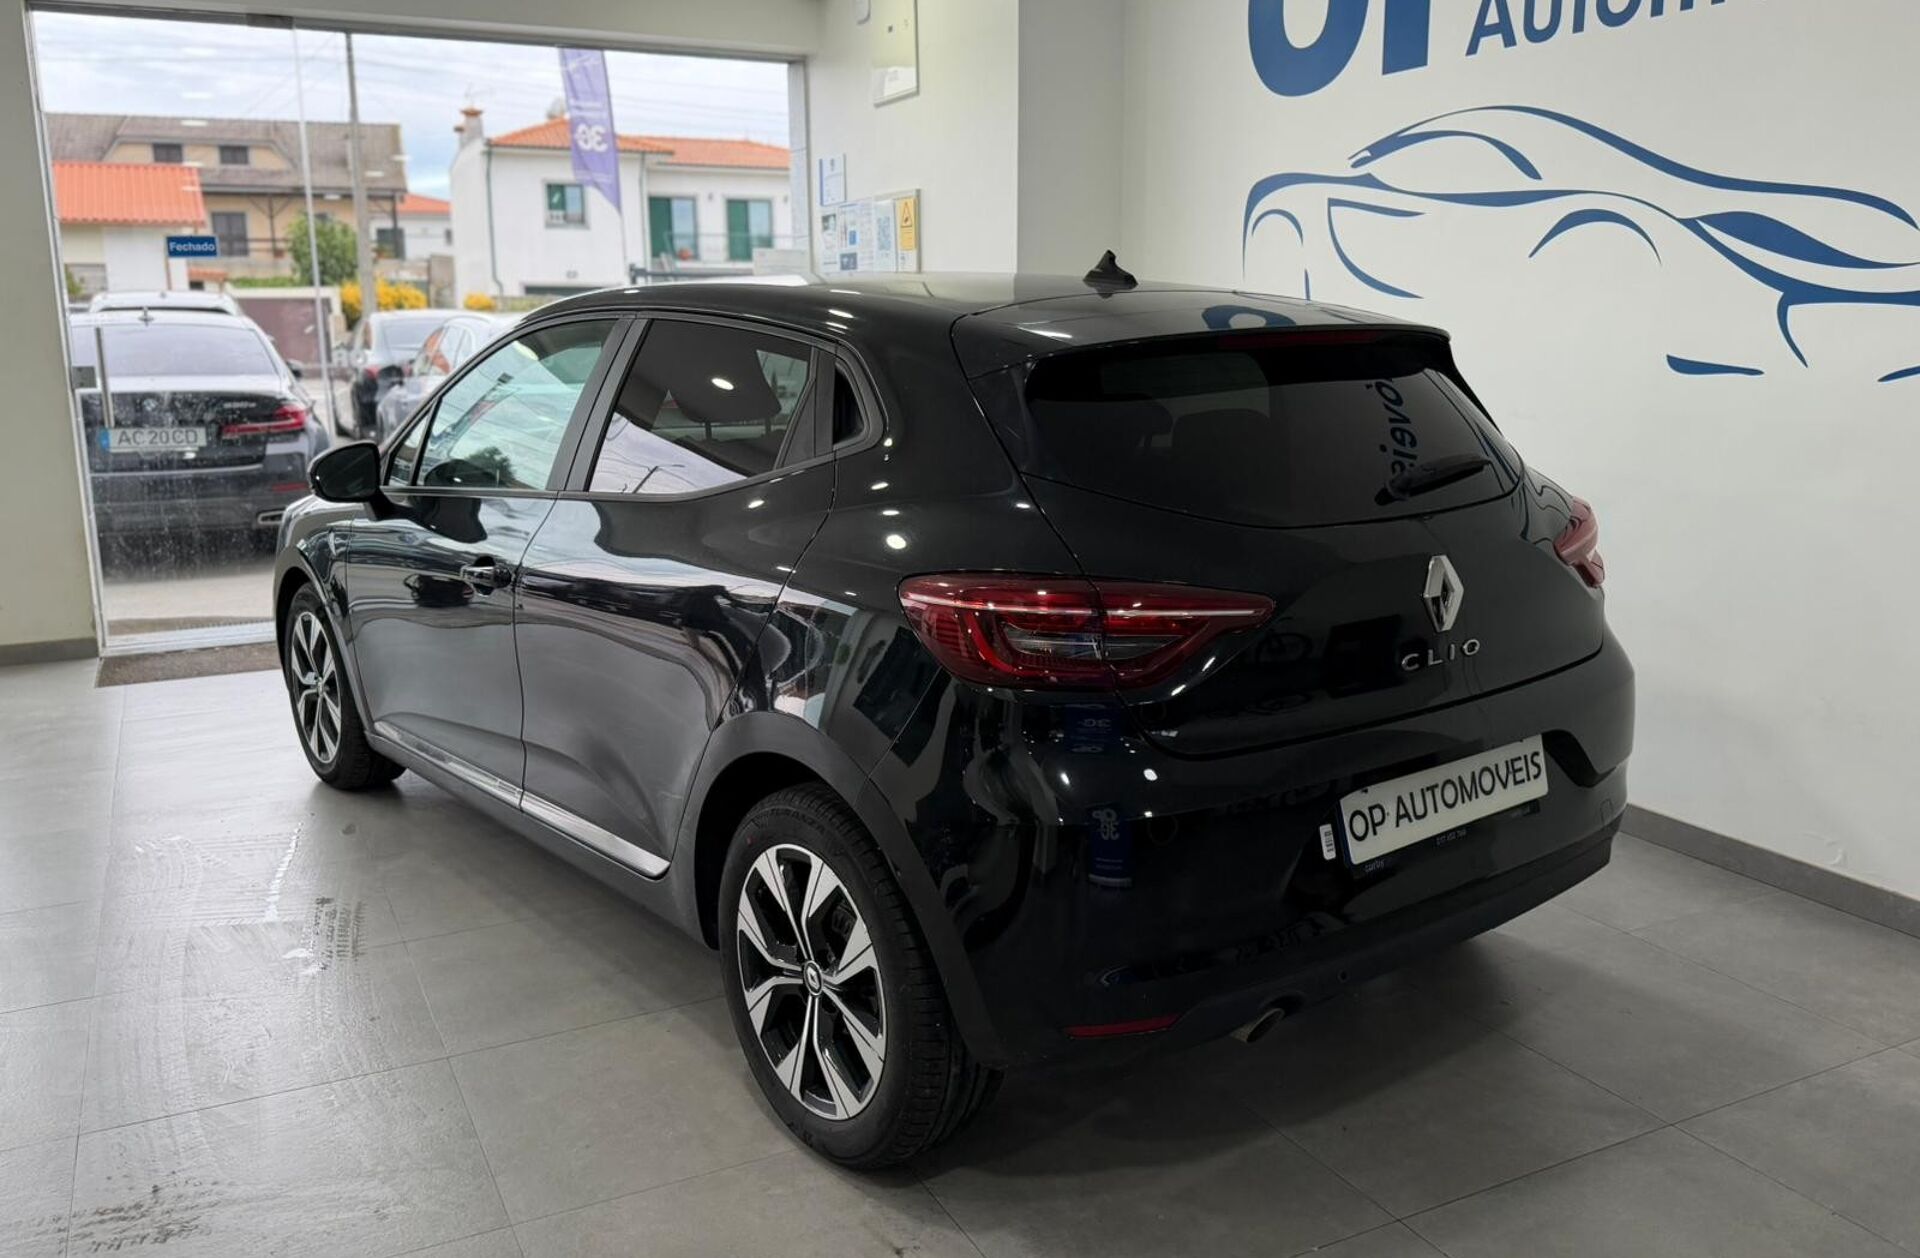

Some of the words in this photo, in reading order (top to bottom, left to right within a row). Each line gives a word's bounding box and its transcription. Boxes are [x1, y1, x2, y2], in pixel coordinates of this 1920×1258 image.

[168, 241, 216, 252] Fechado
[118, 430, 144, 446] AC
[147, 430, 170, 445] 20
[172, 429, 199, 444] CD
[1401, 638, 1480, 671] CLIO
[1349, 803, 1387, 842] OP
[1395, 751, 1542, 828] AUTOMOVEIS
